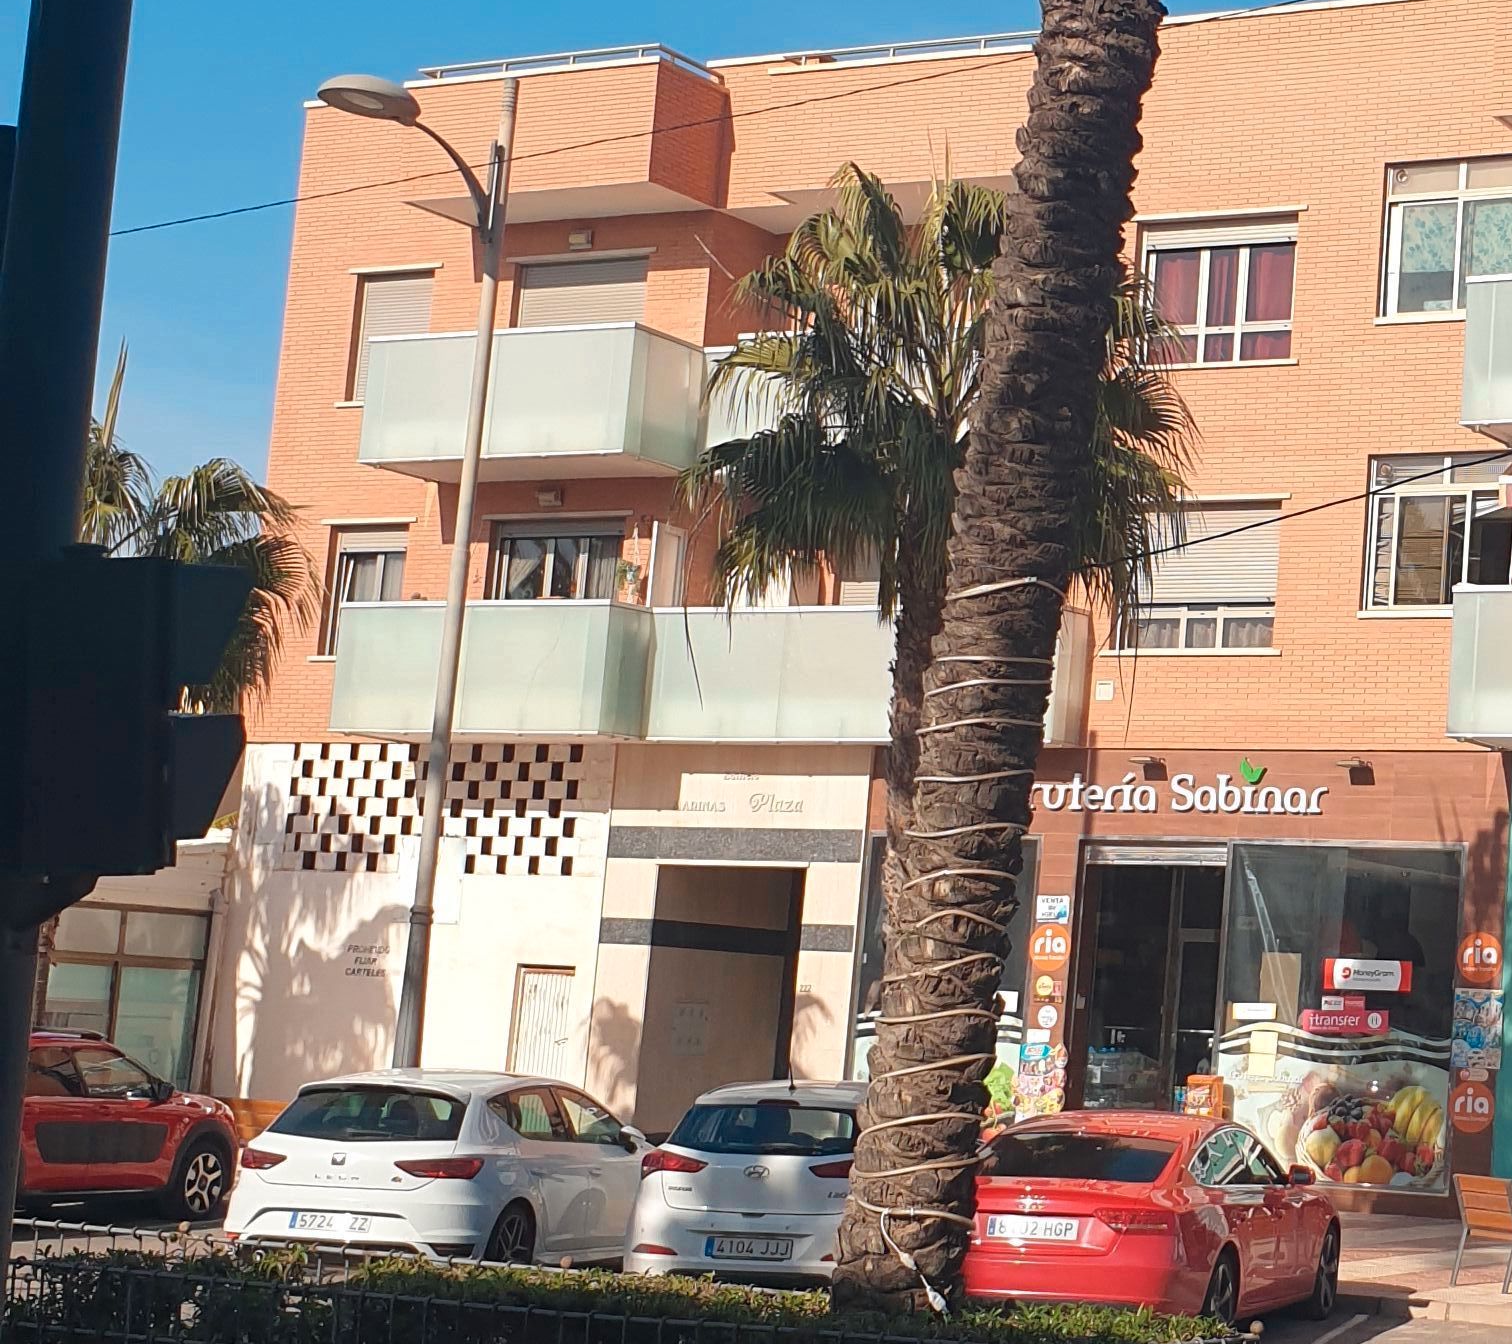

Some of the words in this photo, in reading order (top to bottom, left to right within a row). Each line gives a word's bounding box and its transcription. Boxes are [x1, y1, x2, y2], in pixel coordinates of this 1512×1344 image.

[1030, 772, 1156, 812] rutería
[1171, 773, 1329, 814] Sabinar
[681, 800, 727, 813] ARINAS
[749, 792, 805, 814] Plaza
[1034, 928, 1067, 954] ria
[1462, 938, 1498, 964] ria
[1353, 969, 1395, 978] MoneyGram
[1309, 1013, 1360, 1027] itransfer
[1454, 1087, 1489, 1114] ria
[349, 1216, 369, 1232] ZZ
[1044, 1221, 1074, 1238] HGP
[716, 1239, 754, 1254] 4104
[760, 1241, 791, 1256] JJJ
